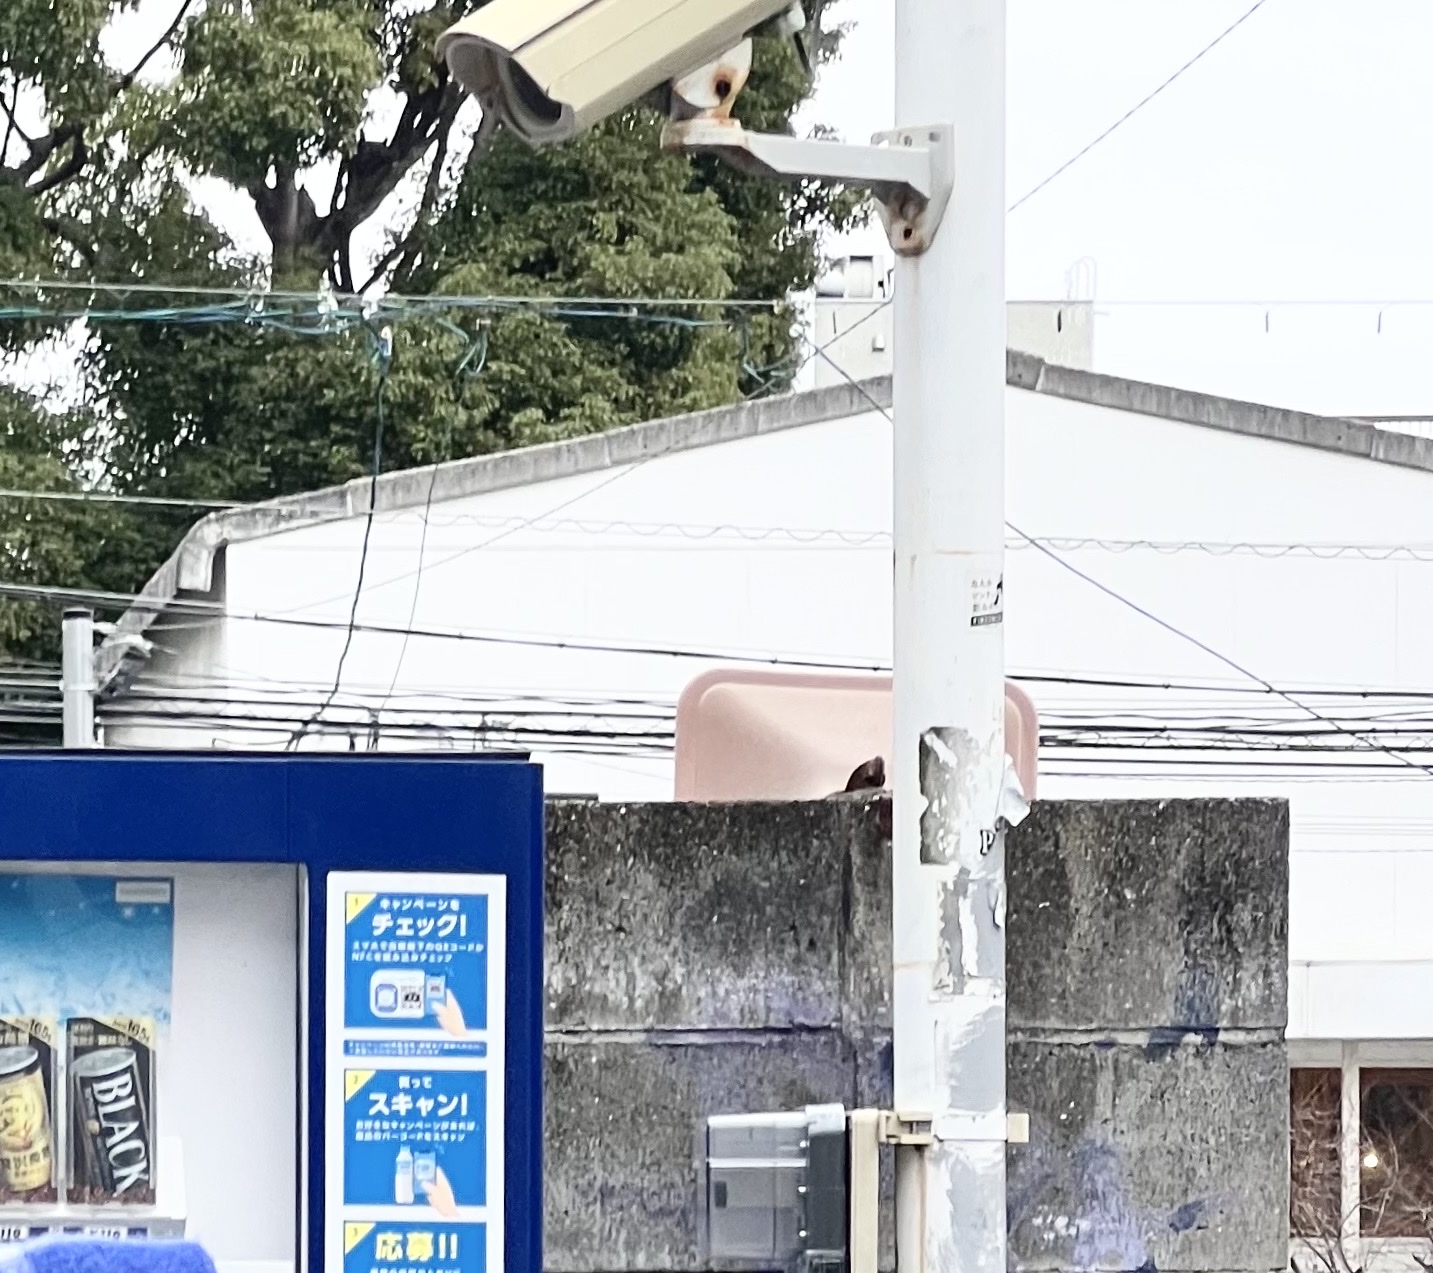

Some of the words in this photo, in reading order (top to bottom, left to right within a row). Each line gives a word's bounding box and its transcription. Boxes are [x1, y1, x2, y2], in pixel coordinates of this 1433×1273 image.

[372, 914, 467, 938] チェック!
[368, 1093, 468, 1117] スキャン!
[92, 1071, 150, 1198] BLACK
